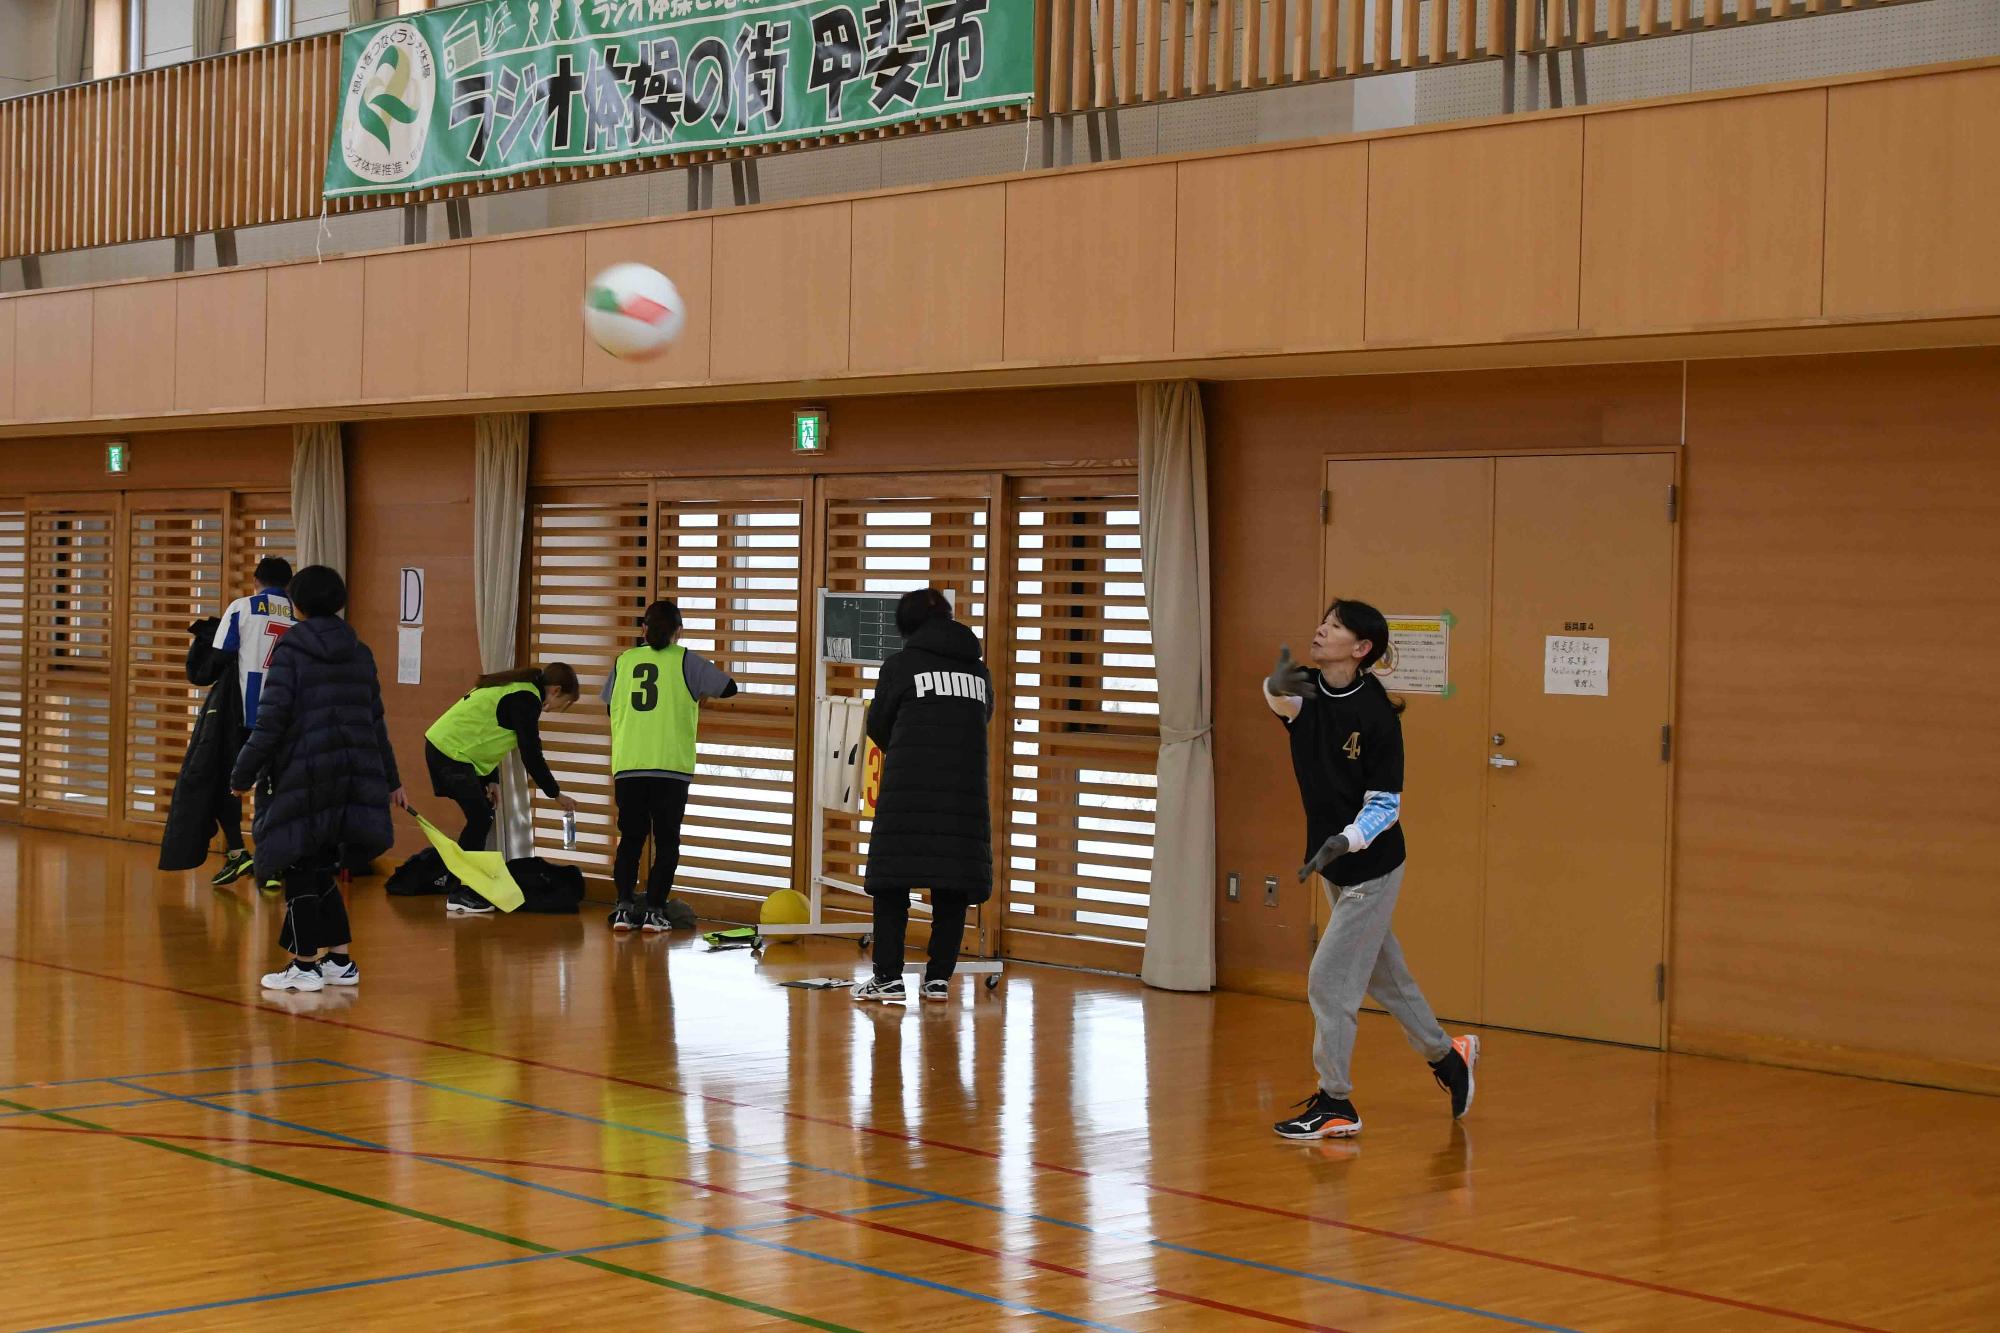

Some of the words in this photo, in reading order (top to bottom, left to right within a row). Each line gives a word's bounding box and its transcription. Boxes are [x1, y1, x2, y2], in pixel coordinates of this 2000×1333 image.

[449, 20, 790, 165] ラジオ体操の街
[807, 0, 989, 122] 甲斐市
[402, 568, 421, 621] D
[631, 662, 659, 712] 3
[914, 671, 986, 704] PUMA
[1342, 731, 1361, 760] 4
